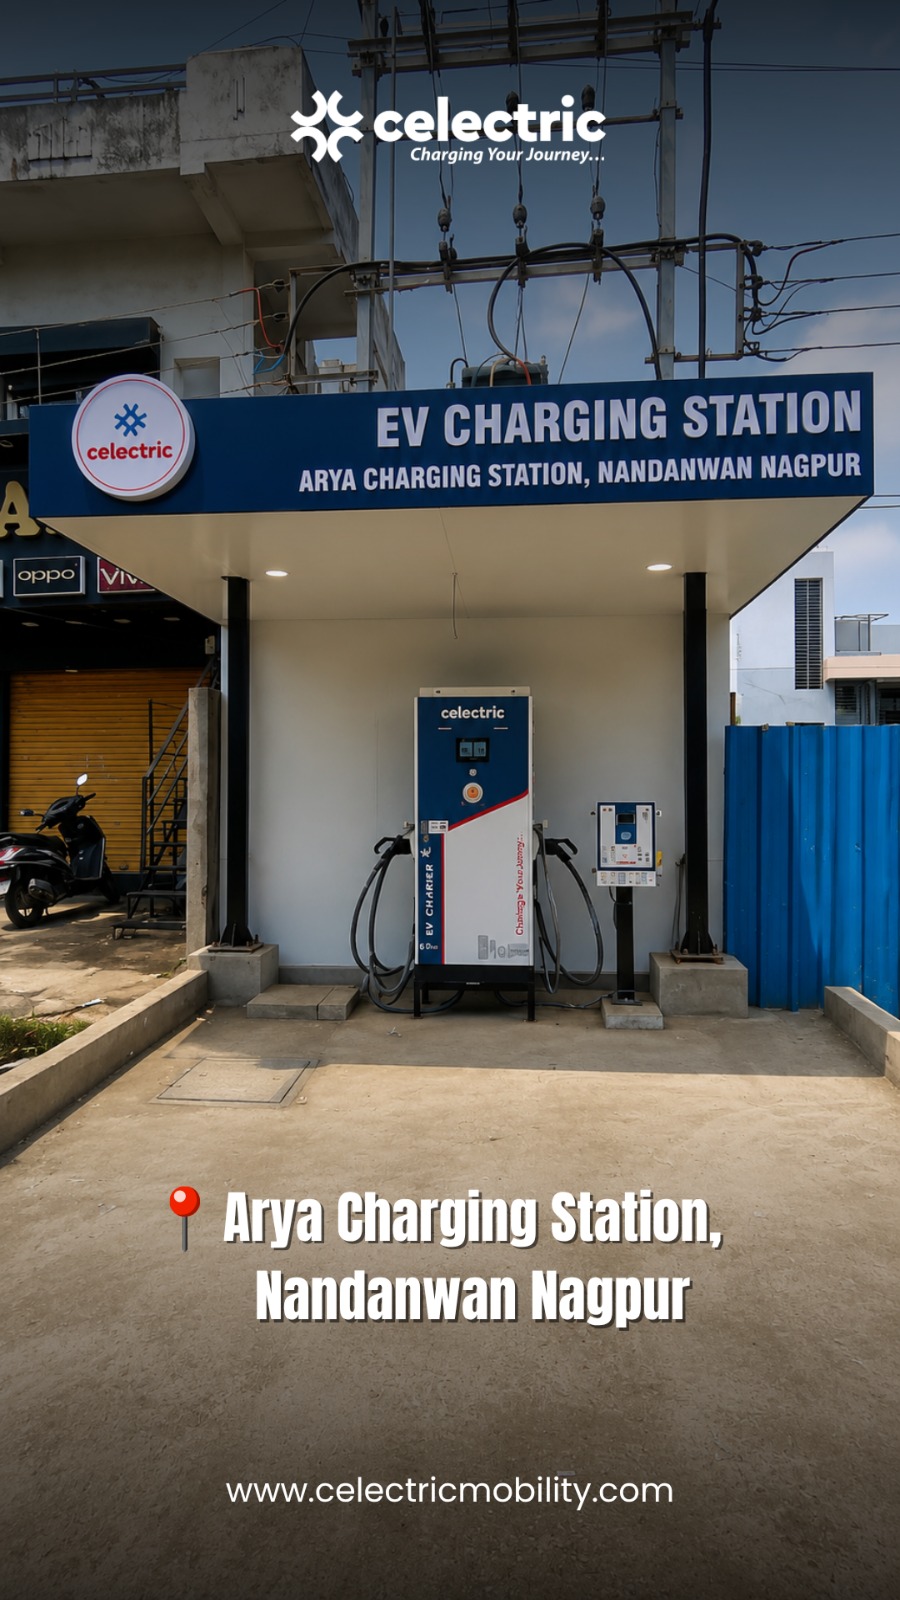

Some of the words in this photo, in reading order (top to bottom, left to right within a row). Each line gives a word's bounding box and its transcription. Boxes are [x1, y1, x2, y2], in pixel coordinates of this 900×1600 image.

[377, 405, 430, 448] EV
[443, 396, 667, 447] CHARGING
[682, 389, 861, 439] STATION
[86, 440, 173, 461] celectric
[299, 468, 357, 492] ARYA
[363, 464, 482, 491] CHARGING
[488, 461, 591, 489] STATION,
[598, 456, 752, 484] NANDANWAN
[760, 452, 862, 479] NAGPUR
[18, 568, 75, 584] oppo
[100, 567, 143, 586] viv
[440, 705, 505, 719] celectric
[425, 922, 434, 936] EV
